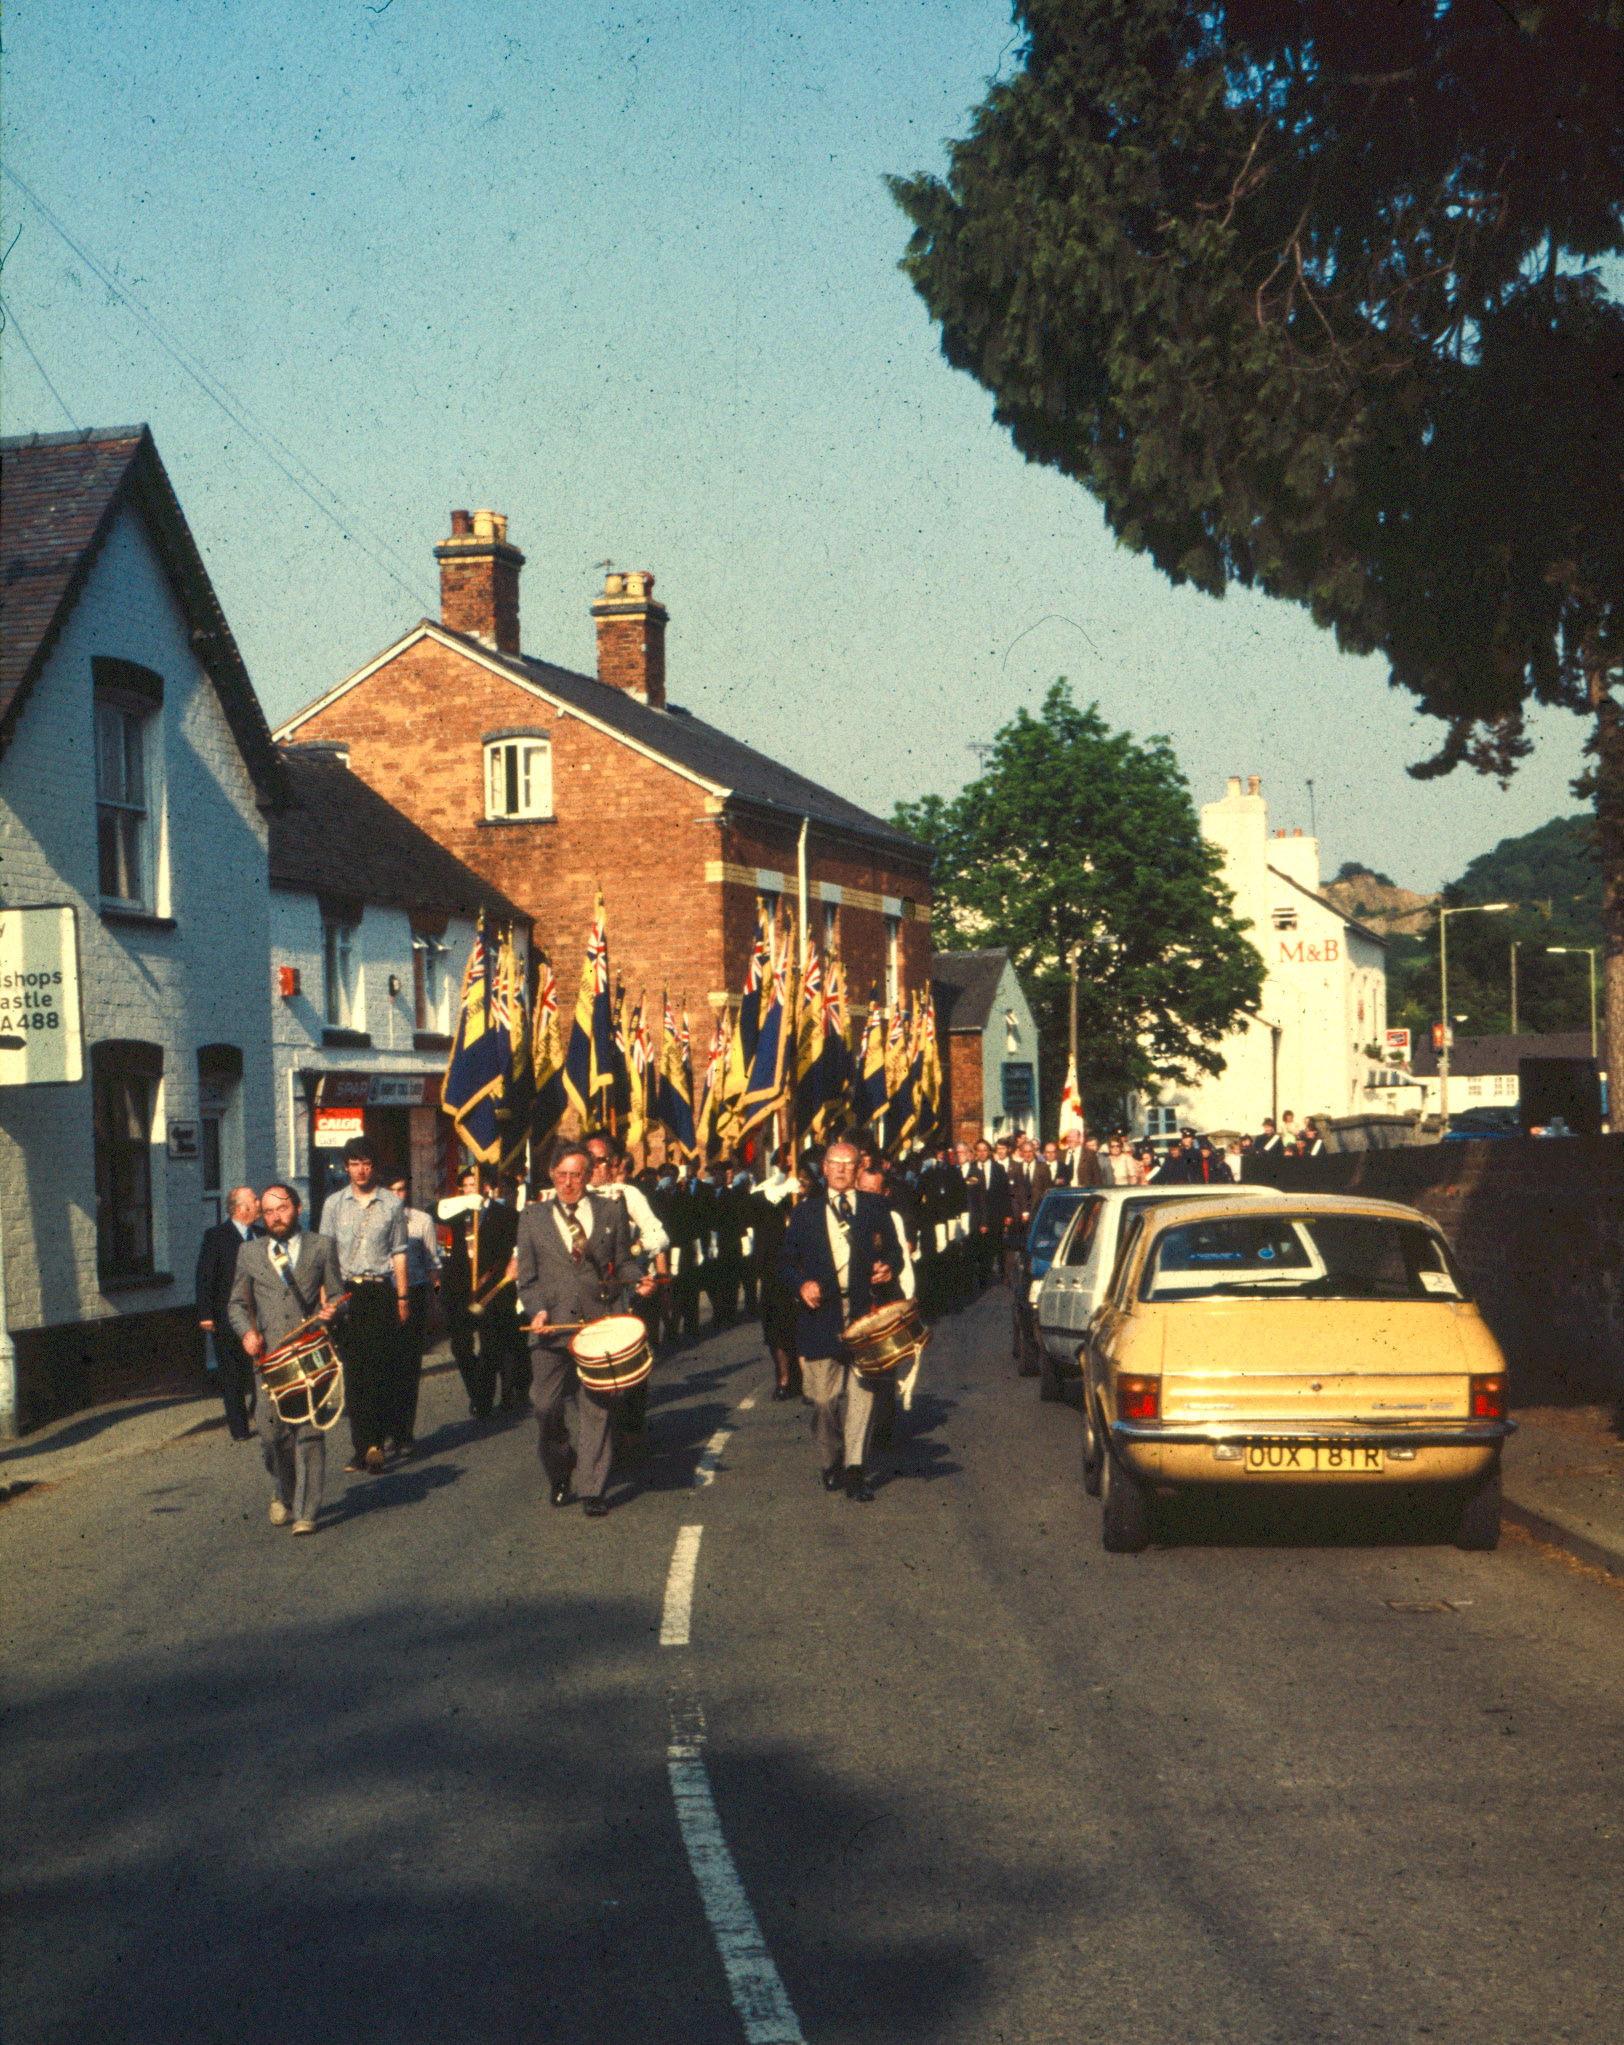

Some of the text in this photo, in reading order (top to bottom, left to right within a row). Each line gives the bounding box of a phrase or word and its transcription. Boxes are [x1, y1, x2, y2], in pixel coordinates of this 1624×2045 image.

[1280, 940, 1339, 963] M&B
[1, 1012, 60, 1032] A488
[1250, 1446, 1301, 1467] OUX
